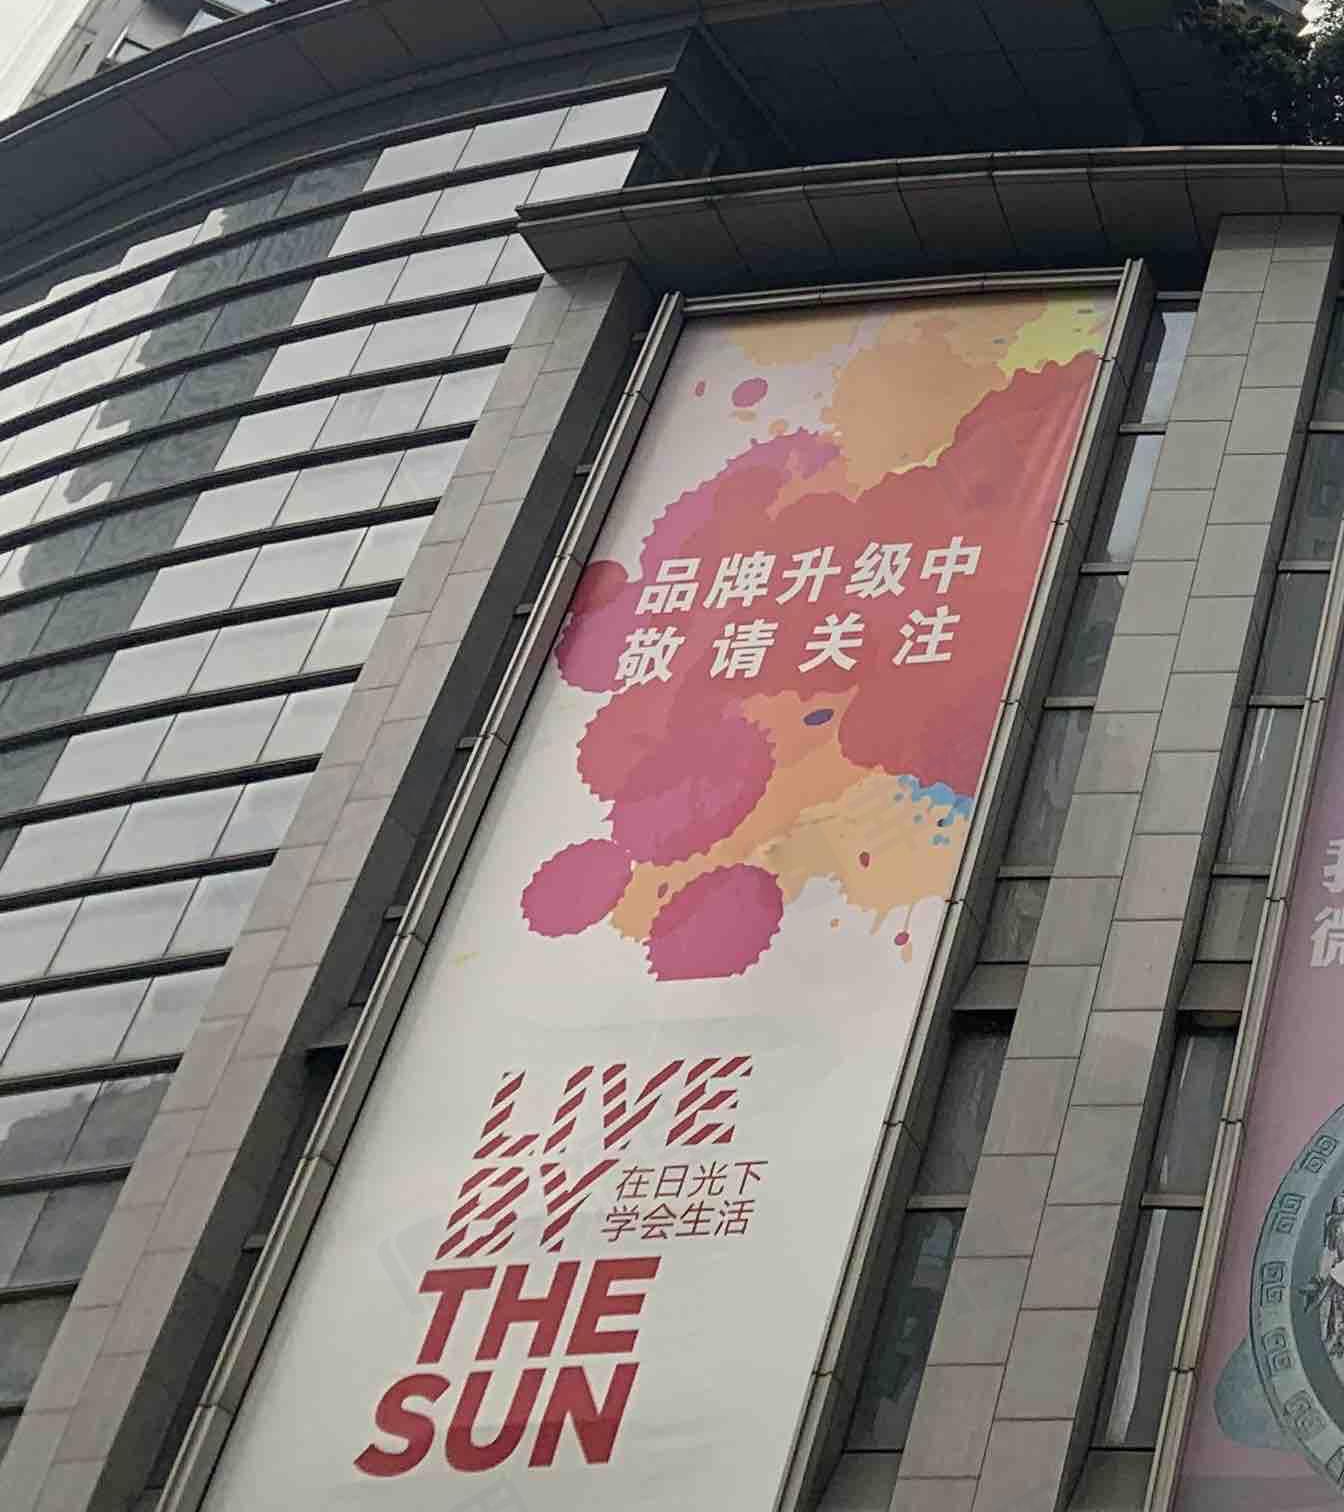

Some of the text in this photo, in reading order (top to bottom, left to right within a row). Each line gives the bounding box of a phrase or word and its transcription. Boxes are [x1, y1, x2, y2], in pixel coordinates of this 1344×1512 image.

[635, 536, 981, 615] 品牌升级中
[614, 605, 961, 685] 敬请关注
[472, 1055, 753, 1159] LIVE
[435, 1159, 620, 1260] BY
[602, 1199, 756, 1242] 学会生活
[616, 1160, 768, 1201] 在日光下
[416, 1256, 662, 1365] THE
[353, 1362, 640, 1478] SUN
